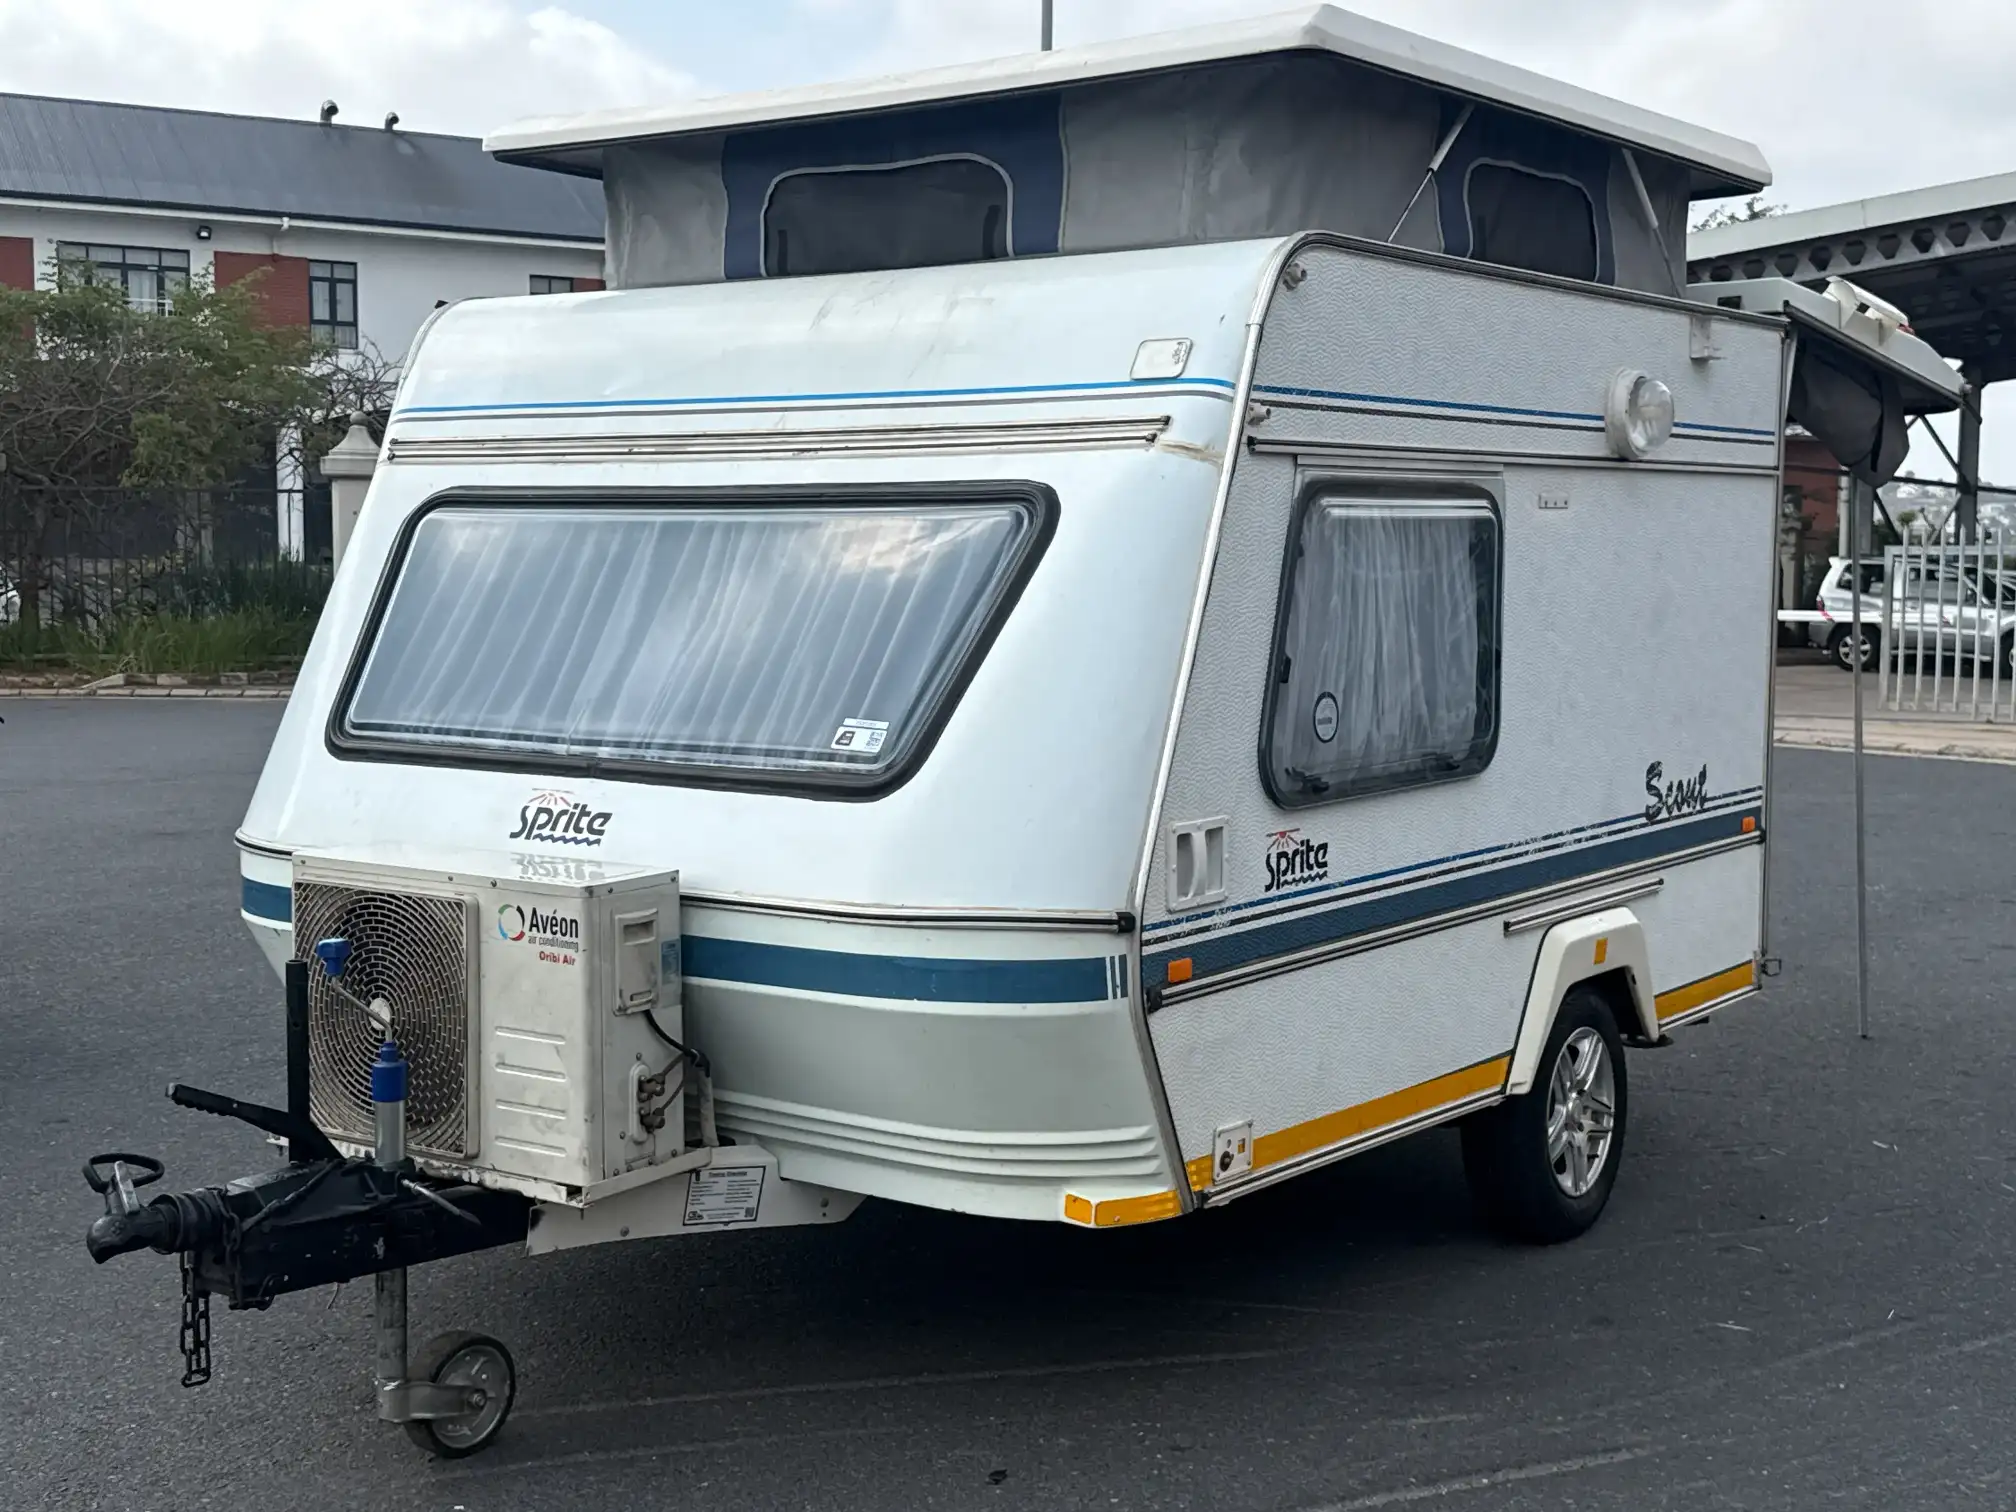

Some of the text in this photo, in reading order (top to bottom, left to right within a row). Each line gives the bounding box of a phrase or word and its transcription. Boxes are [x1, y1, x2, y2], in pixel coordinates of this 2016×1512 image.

[509, 803, 613, 840] Sprite
[1264, 838, 1328, 892] Sprite
[528, 907, 578, 938] Avéon
[539, 951, 576, 966] Oribi Air
